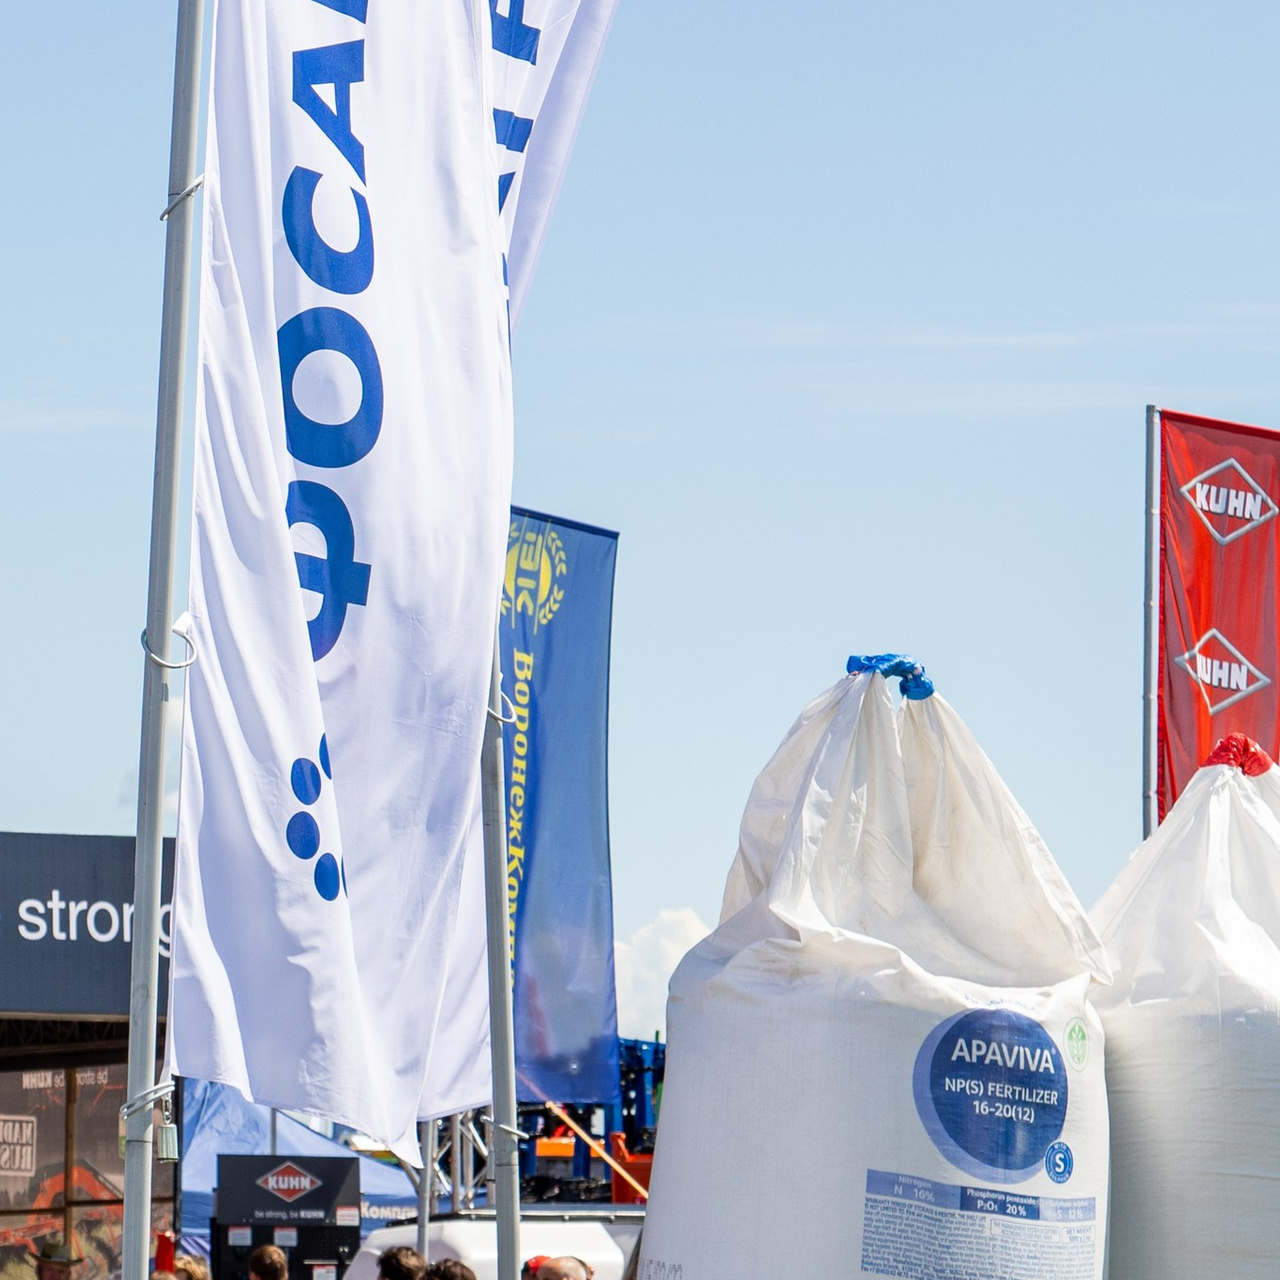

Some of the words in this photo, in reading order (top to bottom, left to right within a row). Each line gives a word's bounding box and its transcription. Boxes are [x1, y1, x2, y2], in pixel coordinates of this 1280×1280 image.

[1195, 481, 1262, 521] KUHN
[950, 1037, 1056, 1075] APAVIVA
[945, 1077, 984, 1097] NP(S)
[987, 1082, 1058, 1106] FERTILIZER
[973, 1100, 1035, 1124] 16-20(12)
[1054, 1152, 1066, 1174] S
[267, 1175, 311, 1191] KUHN
[898, 1175, 932, 1190] Nitrogen
[894, 1184, 903, 1195] N
[913, 1188, 936, 1203] 16%
[966, 1188, 1006, 1201] Phosphorus
[300, 1208, 325, 1219] KUHN
